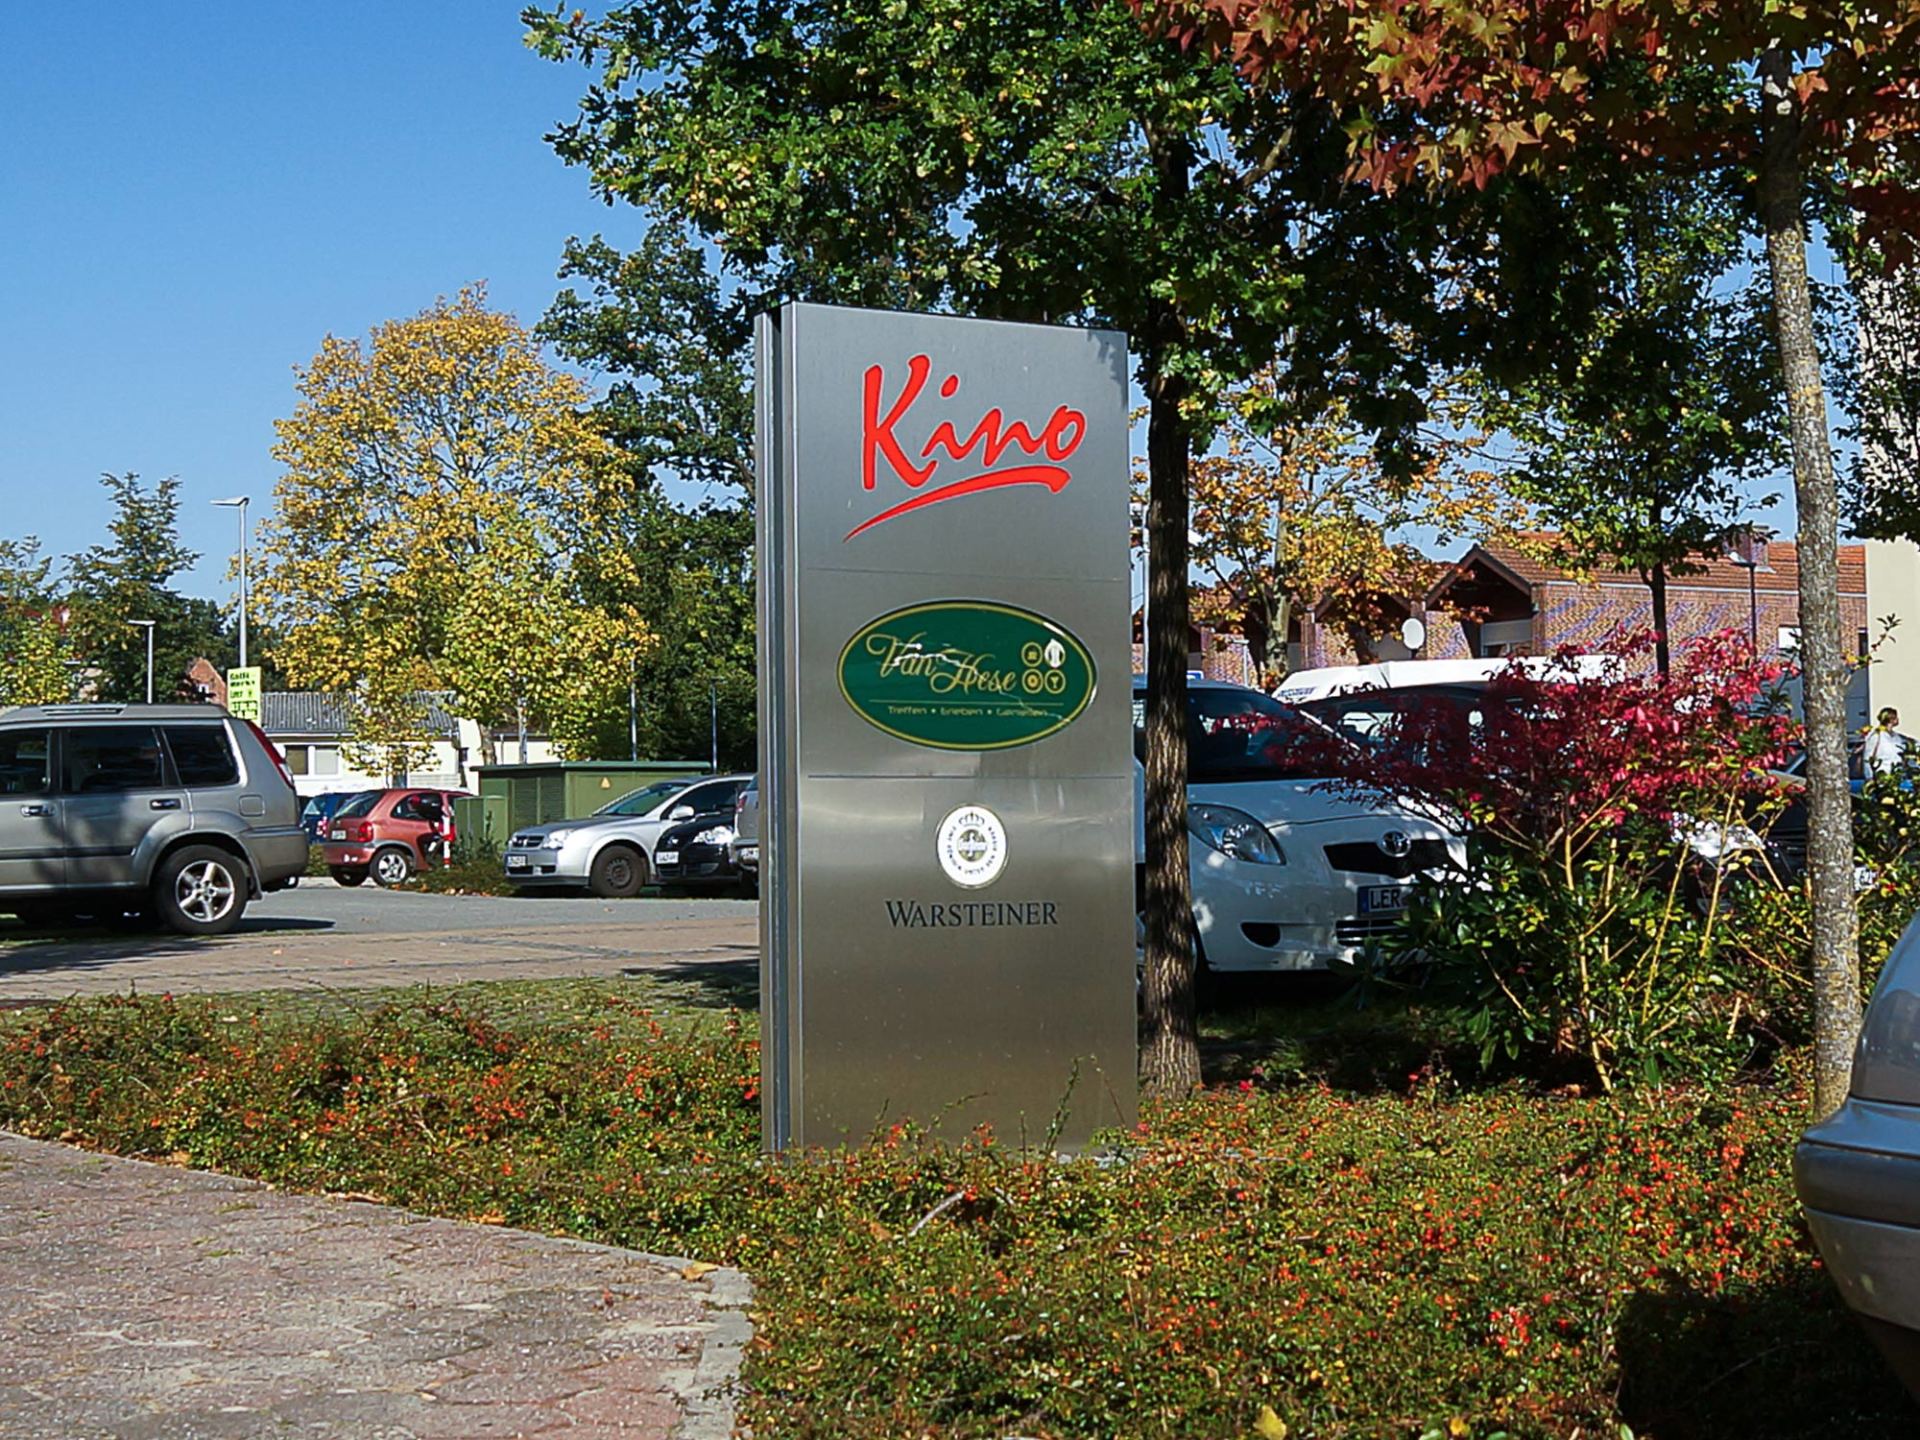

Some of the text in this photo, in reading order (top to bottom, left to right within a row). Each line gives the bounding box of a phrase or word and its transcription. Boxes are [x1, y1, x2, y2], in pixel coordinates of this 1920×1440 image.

[861, 354, 1087, 490] Kino
[866, 631, 938, 678] Van
[885, 900, 1058, 928] WARSTEINER
[1370, 889, 1401, 909] LER
